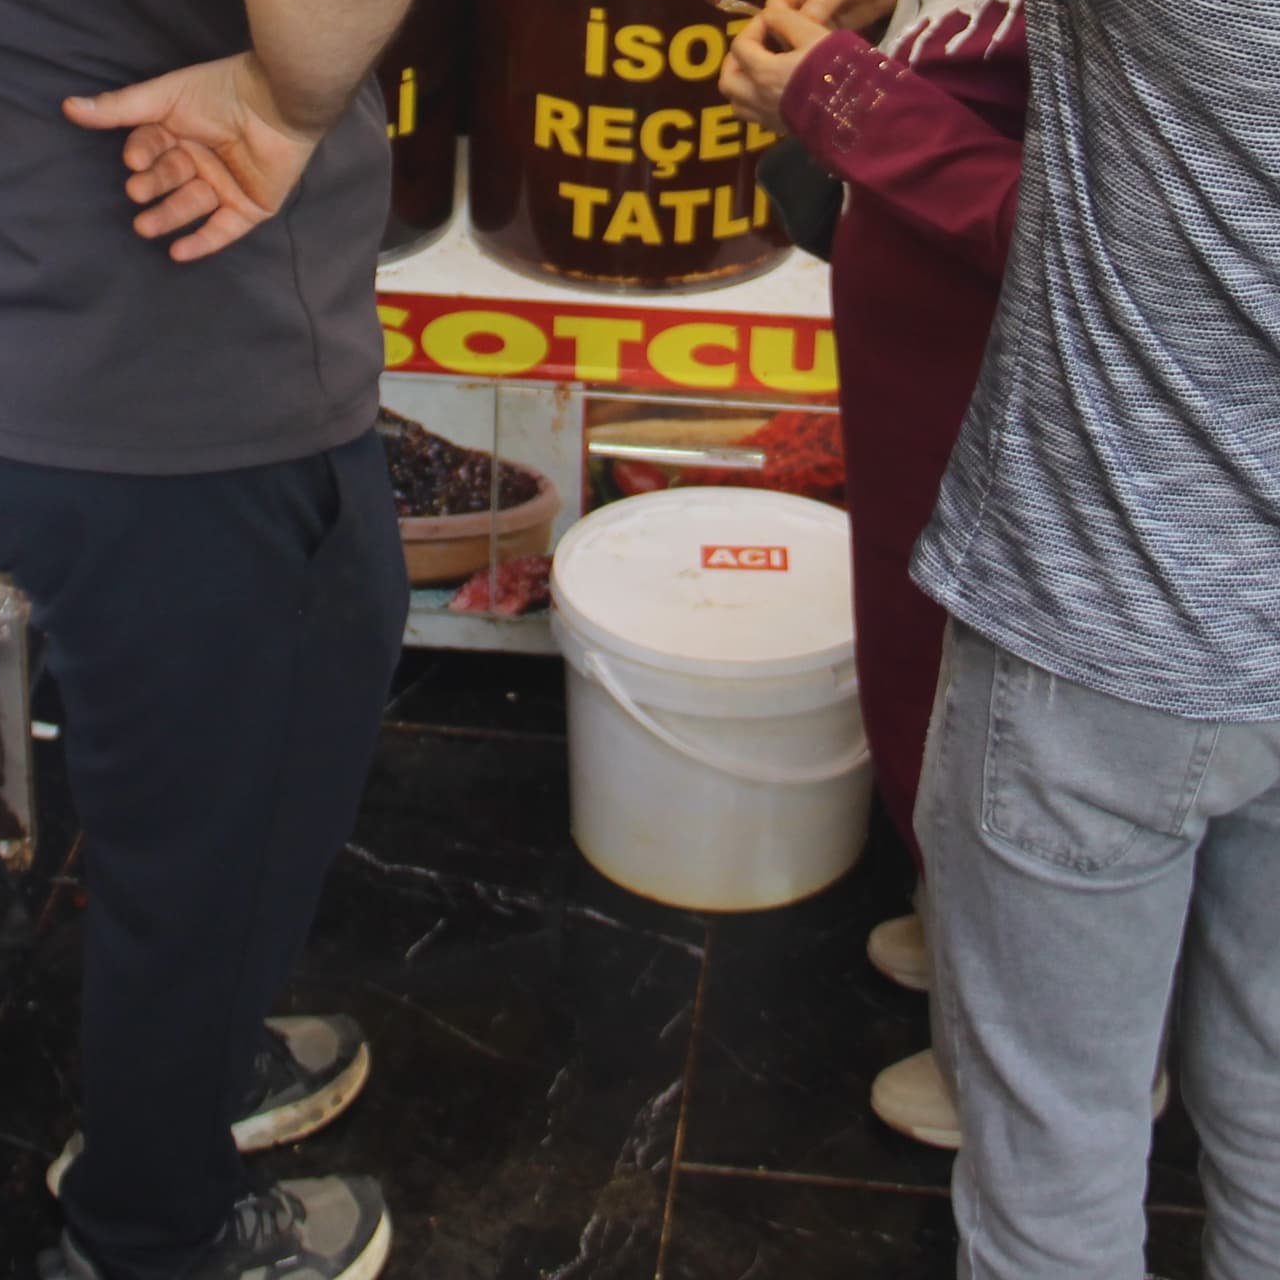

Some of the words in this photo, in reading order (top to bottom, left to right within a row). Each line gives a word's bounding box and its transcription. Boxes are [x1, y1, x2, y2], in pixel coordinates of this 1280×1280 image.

[584, 8, 760, 83] İSO
[375, 303, 842, 395] SOTCU
[706, 548, 784, 570] ACI
